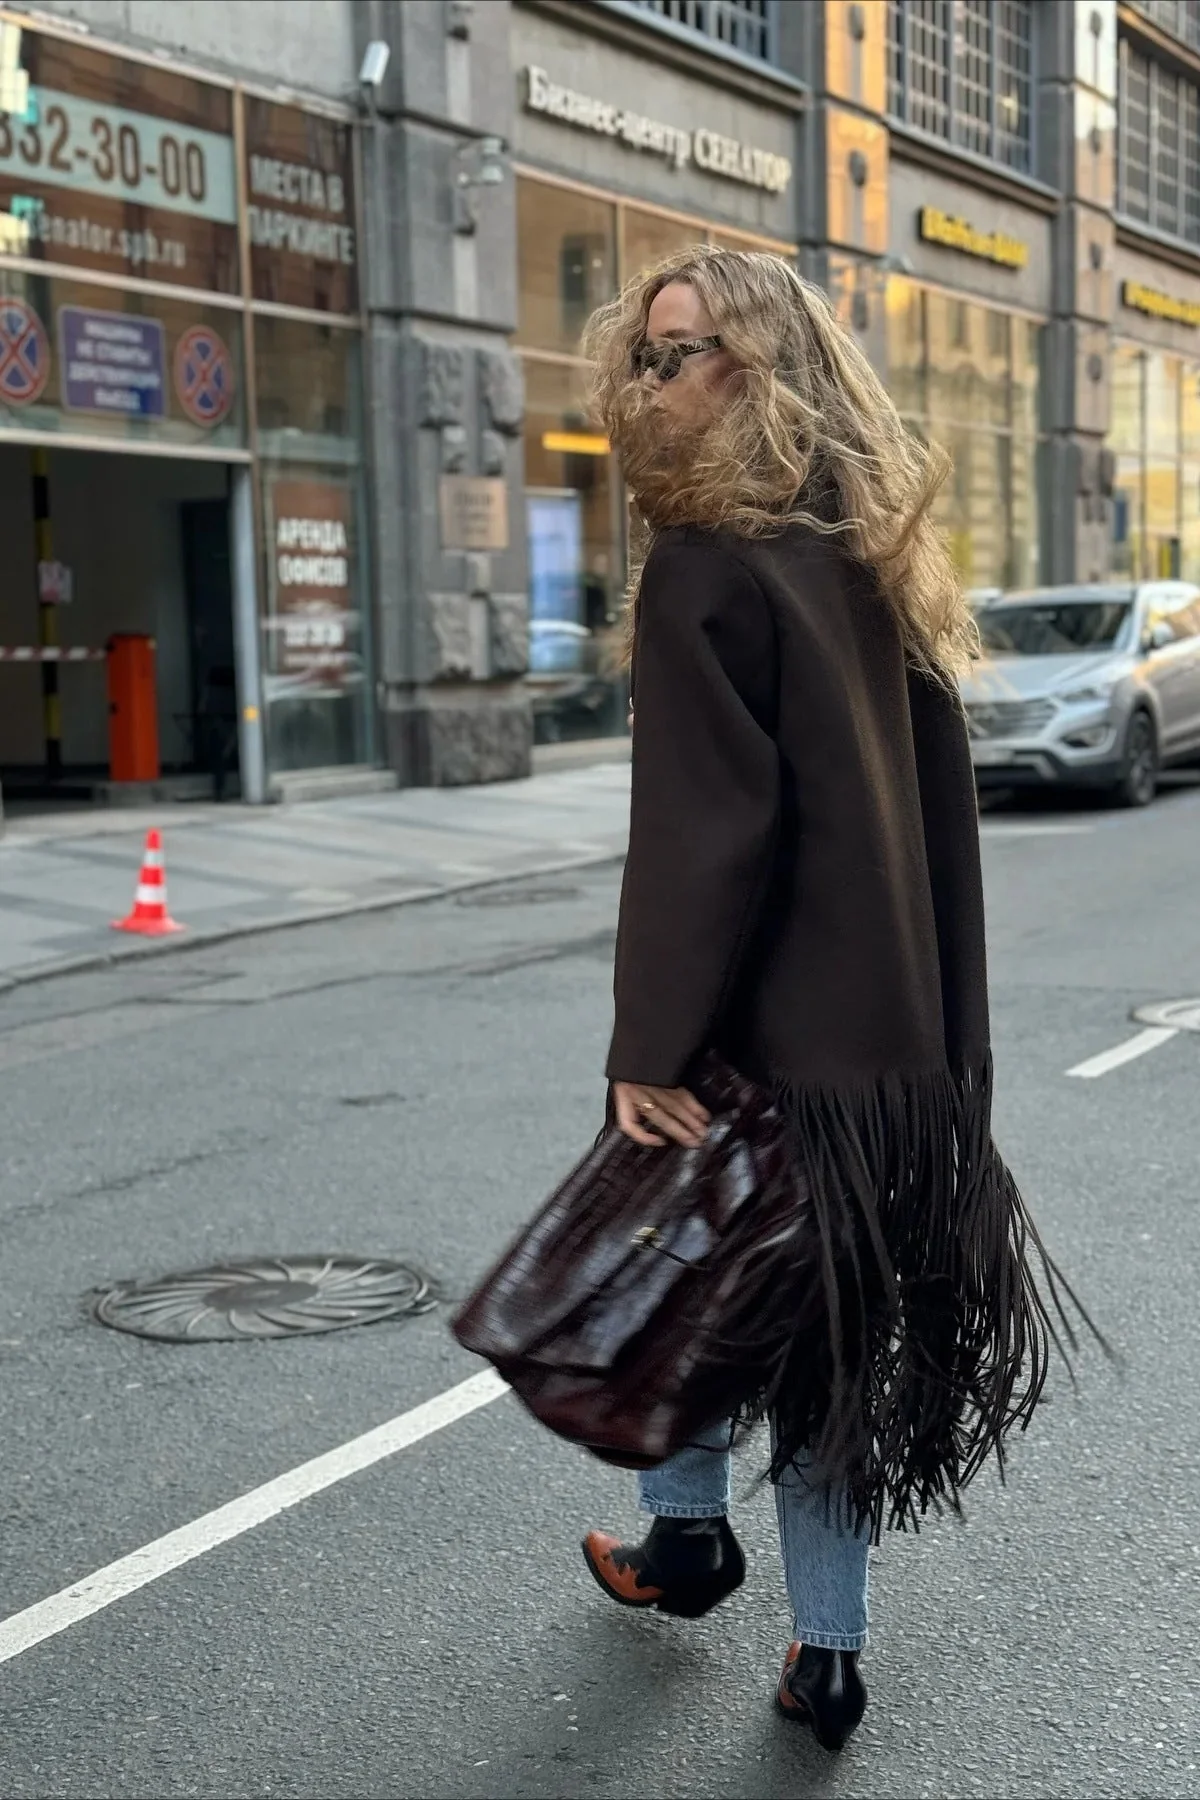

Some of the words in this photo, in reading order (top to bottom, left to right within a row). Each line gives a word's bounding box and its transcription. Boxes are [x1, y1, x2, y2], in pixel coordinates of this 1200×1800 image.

[529, 64, 691, 167] Бизнес-центр
[694, 128, 791, 193] СЕНАТОР
[250, 154, 326, 209] МЕСТА
[326, 174, 344, 213] В
[247, 204, 354, 265] ПАРКИНГЕ
[277, 517, 347, 554] АРЕНДА
[278, 554, 348, 587] ОФИСОВ
